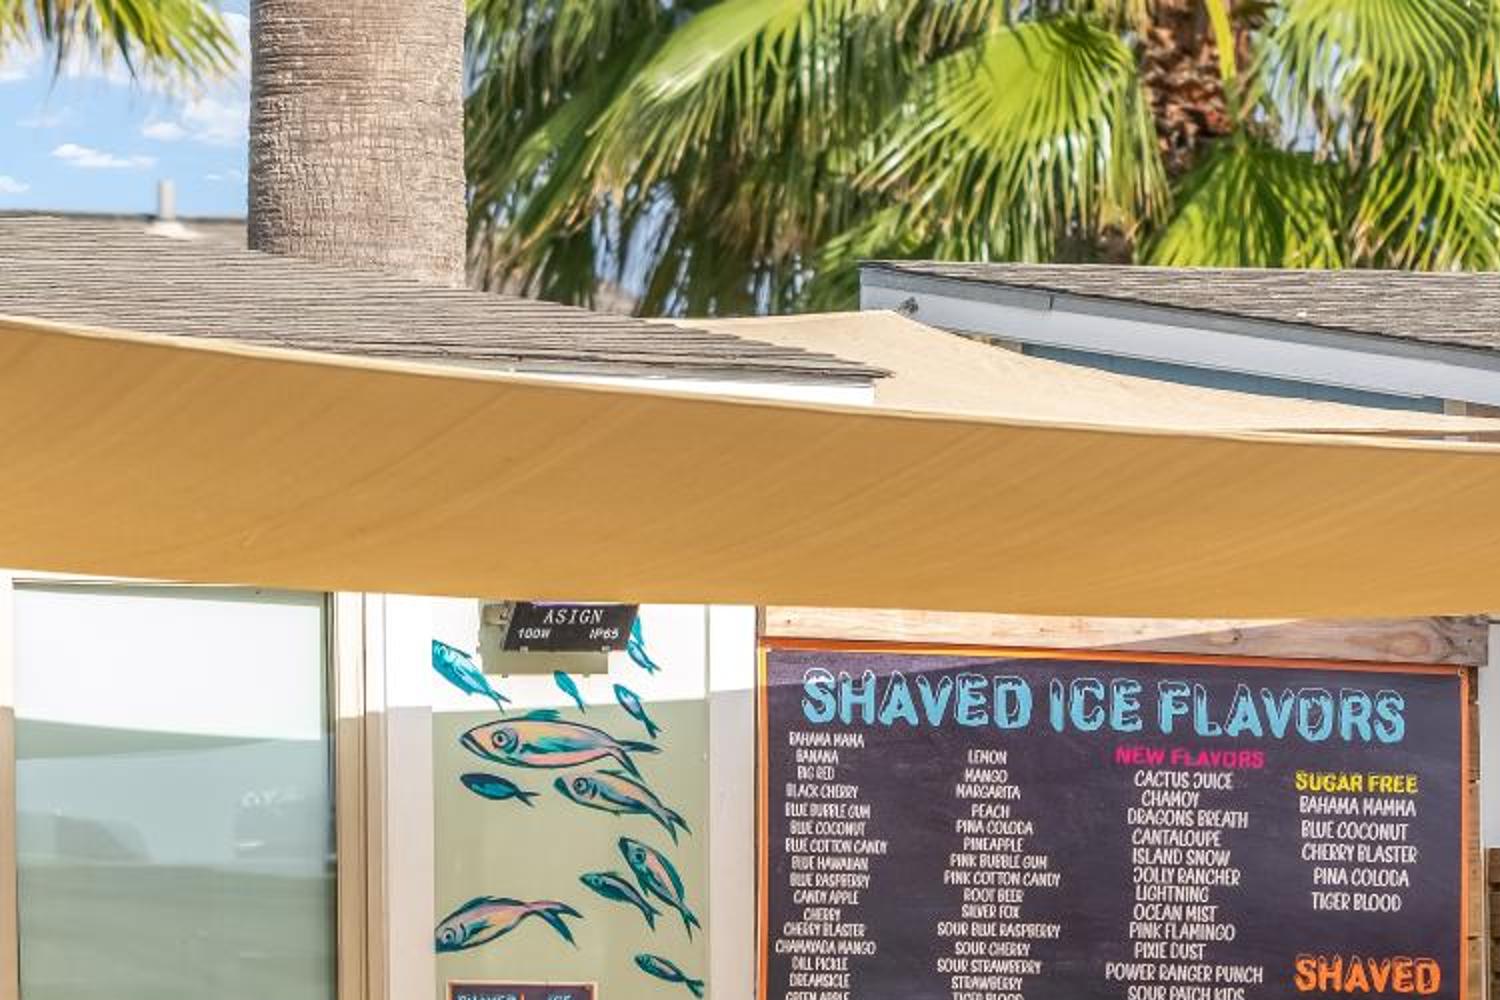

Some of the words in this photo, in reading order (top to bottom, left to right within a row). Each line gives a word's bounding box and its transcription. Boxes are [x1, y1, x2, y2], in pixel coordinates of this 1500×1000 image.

[589, 628, 619, 640] IP65
[803, 668, 1032, 728] SHAVED
[1050, 676, 1142, 731] ICE
[1158, 680, 1405, 743] FLAVORS
[789, 731, 832, 746] BAHAMA
[834, 733, 864, 748] MAMA
[796, 748, 839, 764] BANANA
[968, 749, 1007, 764] LEMON
[1115, 747, 1165, 765] NEW
[1171, 748, 1265, 769] FLAVORS
[798, 765, 814, 780] BIG
[816, 766, 834, 780] RED
[964, 768, 1008, 783] MANGO
[1134, 770, 1190, 788] CACTUS
[1194, 772, 1233, 790] JUICE
[1295, 769, 1362, 792] SUGAR
[1368, 772, 1418, 793] FREE
[786, 783, 818, 797] BLACK
[820, 784, 858, 798] CHERRY
[956, 784, 1021, 800] MARGARITA
[1141, 790, 1199, 808] CHAMOY
[1300, 796, 1359, 815] BAHAMA
[1363, 798, 1416, 816] MAMMA
[785, 802, 808, 816] BLUE
[810, 803, 846, 818] BUBBLE
[848, 804, 870, 819] GUM
[971, 803, 1010, 818] PEACH
[1128, 808, 1194, 826] DRAGONS
[1197, 810, 1248, 828] BREATH
[790, 820, 814, 834] BLUE
[816, 821, 866, 836] COCONUT
[956, 819, 984, 834] PINA
[1302, 820, 1334, 839] BLUE
[1337, 821, 1408, 840] COCONUT
[964, 836, 1024, 852] PINEAPPLE
[1132, 828, 1222, 847] CANTALOUPE
[785, 838, 808, 852] BLUE
[810, 838, 852, 853] COTTON
[854, 839, 887, 854] CANDY
[1302, 843, 1354, 861] CHERRY
[1358, 844, 1418, 864] BLASTER
[791, 855, 815, 870] BLUE
[950, 853, 976, 868] PINK
[980, 854, 1021, 868] BUBBLE
[1022, 855, 1048, 869] GUM
[1132, 848, 1182, 865] ISLAND
[1186, 850, 1231, 866] SNOW
[790, 872, 814, 886] BLUE
[816, 873, 870, 888] RASPBERRY
[944, 870, 972, 884] PINK
[973, 871, 1020, 885] COTTON
[1023, 872, 1060, 888] CANDY
[1133, 867, 1174, 884] JOLLY
[1177, 868, 1240, 886] RANCHER
[1313, 867, 1348, 885] PINA
[794, 890, 826, 904] CANDY
[828, 890, 859, 904] APPLE
[964, 887, 996, 902] ROOT
[997, 888, 1024, 903] BEER
[1136, 885, 1209, 902] LIGHTNING
[1312, 892, 1350, 910] TIGER
[1354, 893, 1402, 912] BLOOD
[804, 908, 841, 921] CHERRY
[962, 904, 996, 918] SILVER
[999, 905, 1020, 918] FOX
[1134, 903, 1182, 921] OCEAN
[1186, 905, 1218, 922] MIST
[784, 922, 821, 936] CHERRY
[823, 923, 864, 937] BLASTER
[937, 922, 968, 936] SOUR
[971, 922, 997, 936] BLUE
[1000, 923, 1060, 938] RASPBERRY
[1129, 922, 1162, 939] PINK
[1165, 923, 1235, 941] FLAMINGO
[838, 940, 877, 955] MANGO
[955, 941, 986, 955] SOUR
[989, 942, 1030, 956] CHERRY
[1134, 941, 1168, 959] PIXIE
[1170, 942, 1206, 960] DUST
[792, 956, 813, 970] DILL
[815, 957, 848, 971] PICKLE
[937, 958, 968, 972] SOUR
[971, 959, 1042, 974] STRAWBERRY
[789, 973, 850, 988] DREAMSICLE
[1106, 962, 1155, 981] POWER
[1159, 964, 1212, 982] RANGER
[1215, 965, 1263, 984] PUNCH
[1294, 953, 1441, 994] SHAVED
[952, 976, 1023, 990] STRAWBERRY
